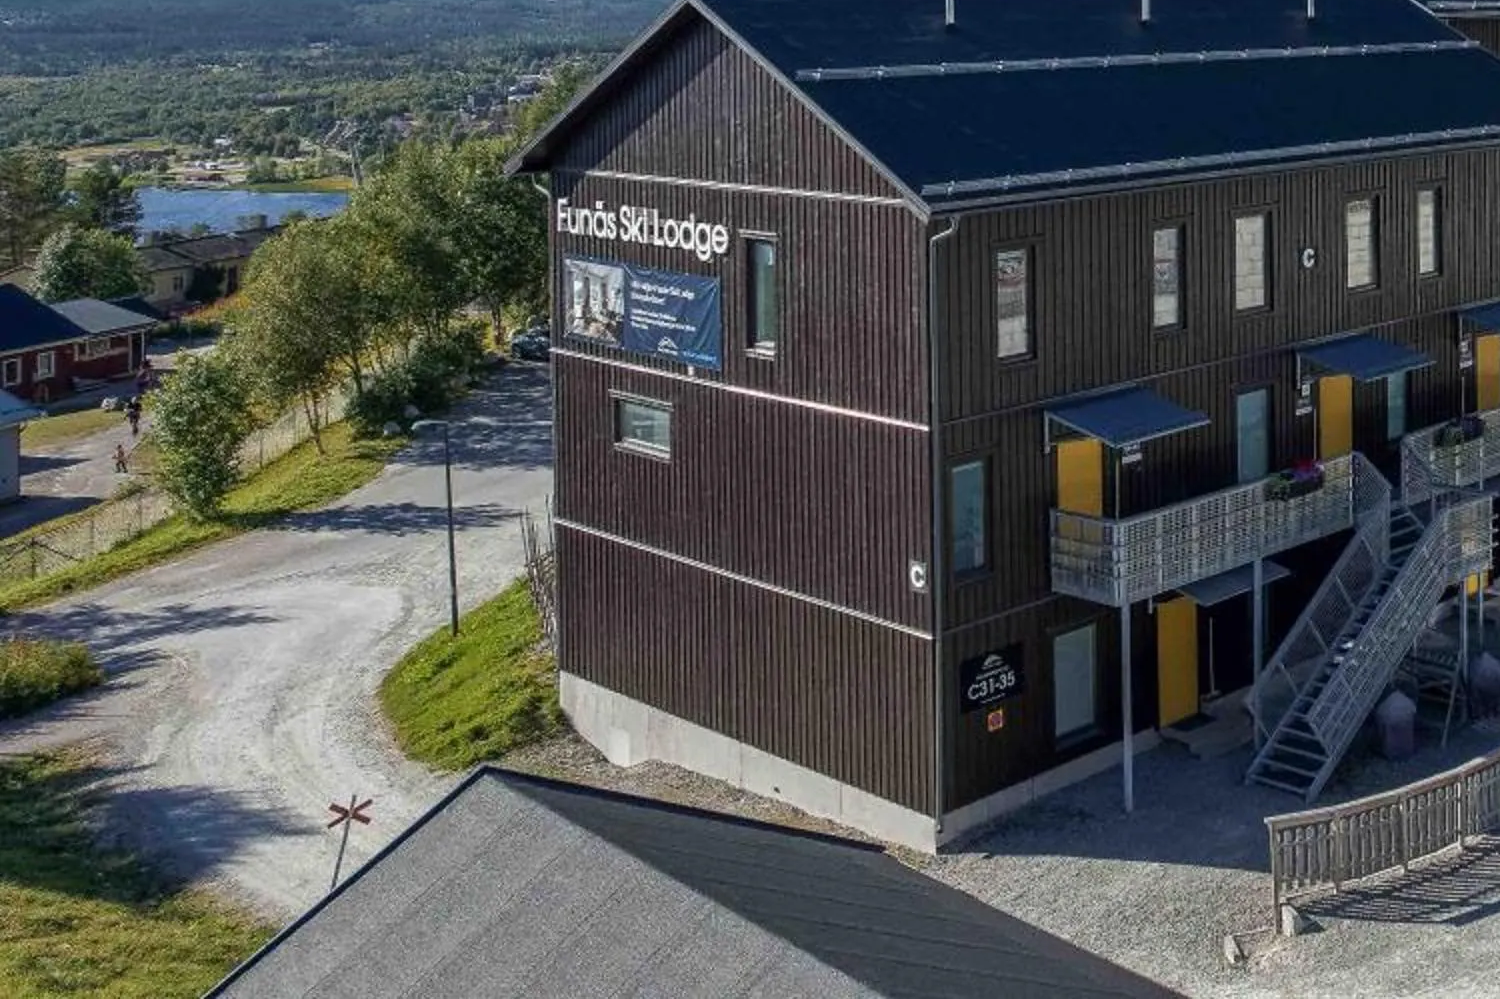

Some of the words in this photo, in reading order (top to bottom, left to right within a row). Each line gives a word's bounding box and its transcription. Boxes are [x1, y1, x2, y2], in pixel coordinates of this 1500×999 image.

[557, 198, 617, 240] Funäs
[619, 205, 648, 244] Ski
[652, 208, 729, 261] Lodge
[1303, 248, 1315, 268] C
[910, 564, 926, 587] C
[967, 669, 1016, 700] C31-35
